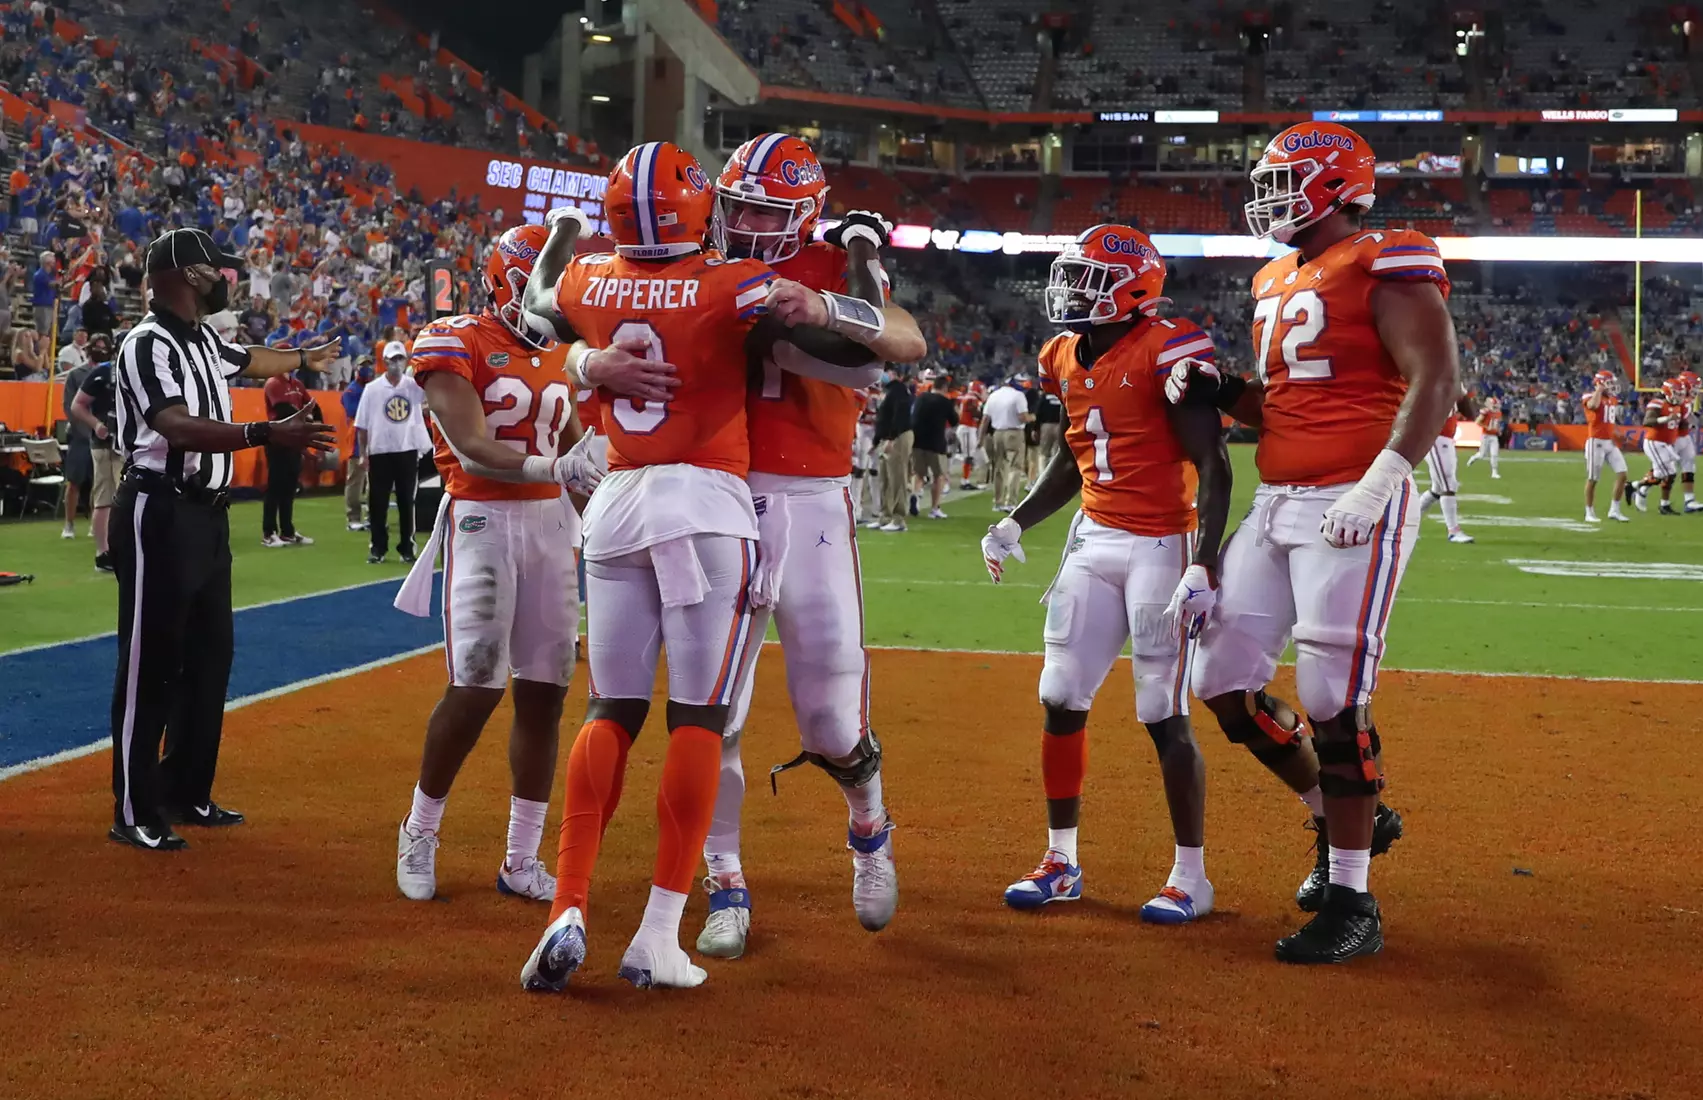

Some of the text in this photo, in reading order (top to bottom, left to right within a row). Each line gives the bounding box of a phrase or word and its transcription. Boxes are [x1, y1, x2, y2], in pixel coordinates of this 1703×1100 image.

[1100, 112, 1149, 122] NISSAN
[1576, 110, 1608, 120] FARGO
[1284, 129, 1354, 153] Gators
[486, 159, 524, 189] SEC
[631, 247, 670, 257] FLORIDA
[434, 268, 453, 311] 2
[581, 276, 699, 309] ZIPPERER
[1253, 287, 1335, 385] 72
[386, 397, 411, 422] SEC
[483, 375, 572, 458] 20
[1085, 406, 1116, 482] 1
